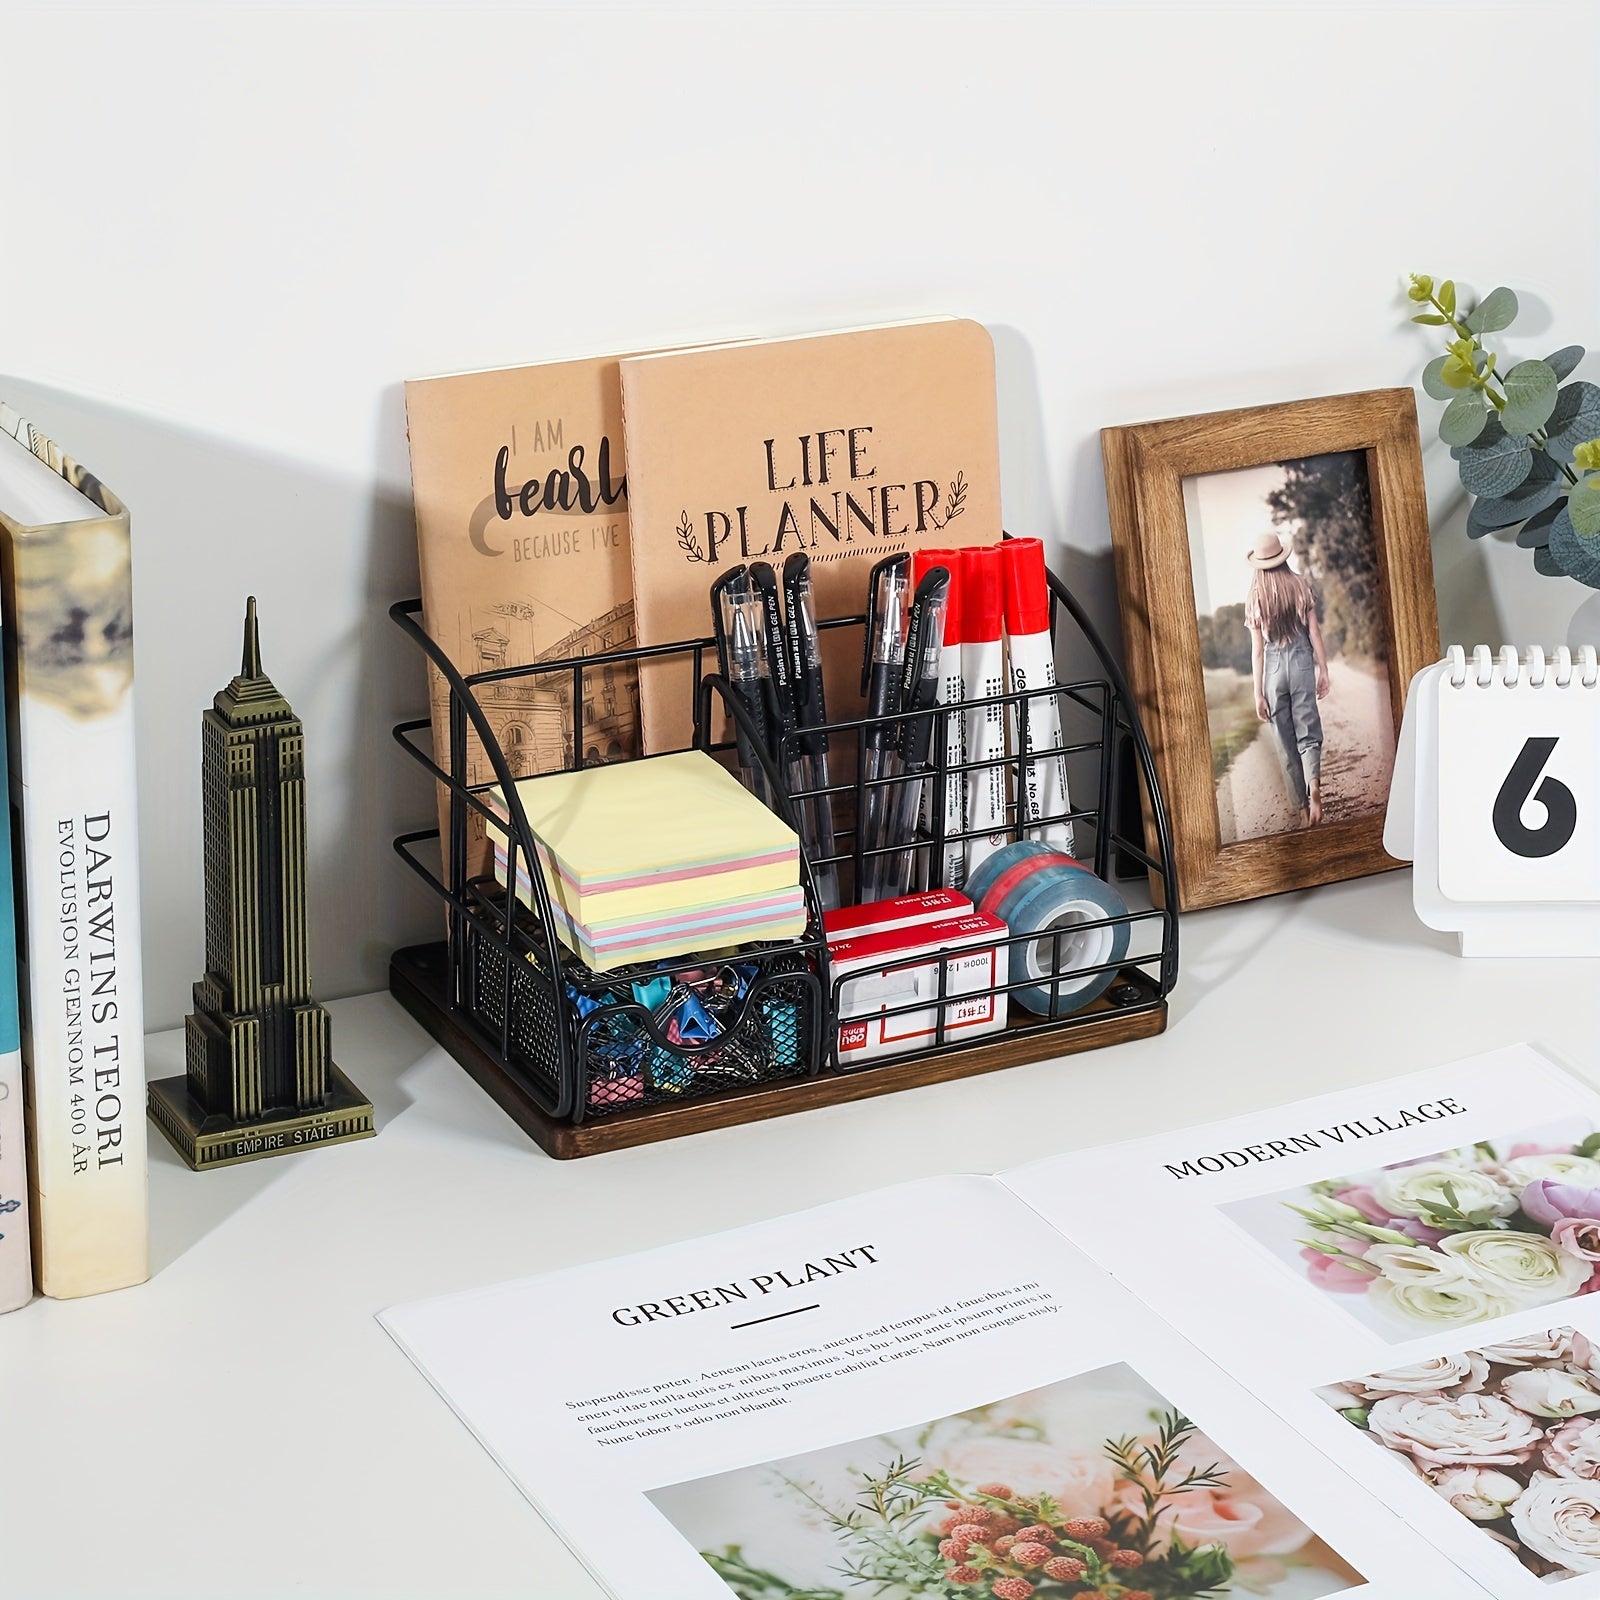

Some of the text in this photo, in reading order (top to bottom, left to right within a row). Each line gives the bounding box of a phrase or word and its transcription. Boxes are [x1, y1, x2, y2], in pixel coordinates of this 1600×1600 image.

[511, 418, 564, 457] I AM
[763, 426, 877, 493] LIFE
[494, 435, 629, 521] fearl
[513, 523, 620, 563] BECAUSE I'VE
[703, 478, 946, 565] PLANNER
[768, 595, 776, 611] PEN
[786, 588, 794, 604] PEN
[788, 605, 796, 619] GEL
[1028, 782, 1040, 823] No.681
[1492, 737, 1577, 858] 6
[58, 819, 90, 1176] EVOLUSJON GJENNOM 400 ÅR
[83, 810, 125, 1170] DARWINS TEORI
[957, 1004, 987, 1019] 订书钉
[841, 1034, 865, 1046] deli
[236, 1124, 335, 1155] EMPIRE STATE
[1162, 1097, 1468, 1180] MODERN VILLAGE
[612, 1244, 879, 1327] GREEN PLANT
[565, 1387, 651, 1410] Suspendisse
[652, 1377, 691, 1393] poten
[700, 1364, 751, 1381] Aenean
[751, 1354, 788, 1368] lacus
[788, 1346, 823, 1359] eros,
[822, 1333, 864, 1350] auctor
[866, 1325, 889, 1338] sed
[889, 1312, 937, 1331] tempus
[956, 1289, 1013, 1309] faucibus
[1022, 1280, 1040, 1291] mi
[576, 1409, 611, 1422] enen
[612, 1402, 648, 1414] vitae
[649, 1393, 685, 1407] nulla
[687, 1385, 717, 1399] quis
[718, 1382, 735, 1390] ex
[739, 1372, 778, 1386] nibus
[845, 1347, 871, 1357] Ves
[924, 1322, 952, 1335] ante
[952, 1308, 994, 1326] ipsum
[995, 1296, 1038, 1314] primis
[1038, 1291, 1053, 1300] in
[587, 1416, 646, 1435] faucibus
[646, 1408, 673, 1422] orci
[673, 1400, 716, 1415] luctus
[716, 1396, 729, 1405] et
[731, 1384, 781, 1402] ultrices
[782, 1371, 833, 1391] posuere
[834, 1359, 879, 1377] cubilia
[922, 1335, 956, 1350] Nam
[956, 1328, 981, 1340] non
[981, 1313, 1028, 1331] congue
[596, 1433, 635, 1447] Nunc
[635, 1422, 673, 1439] lobor
[683, 1415, 713, 1428] odio
[714, 1408, 741, 1420] non
